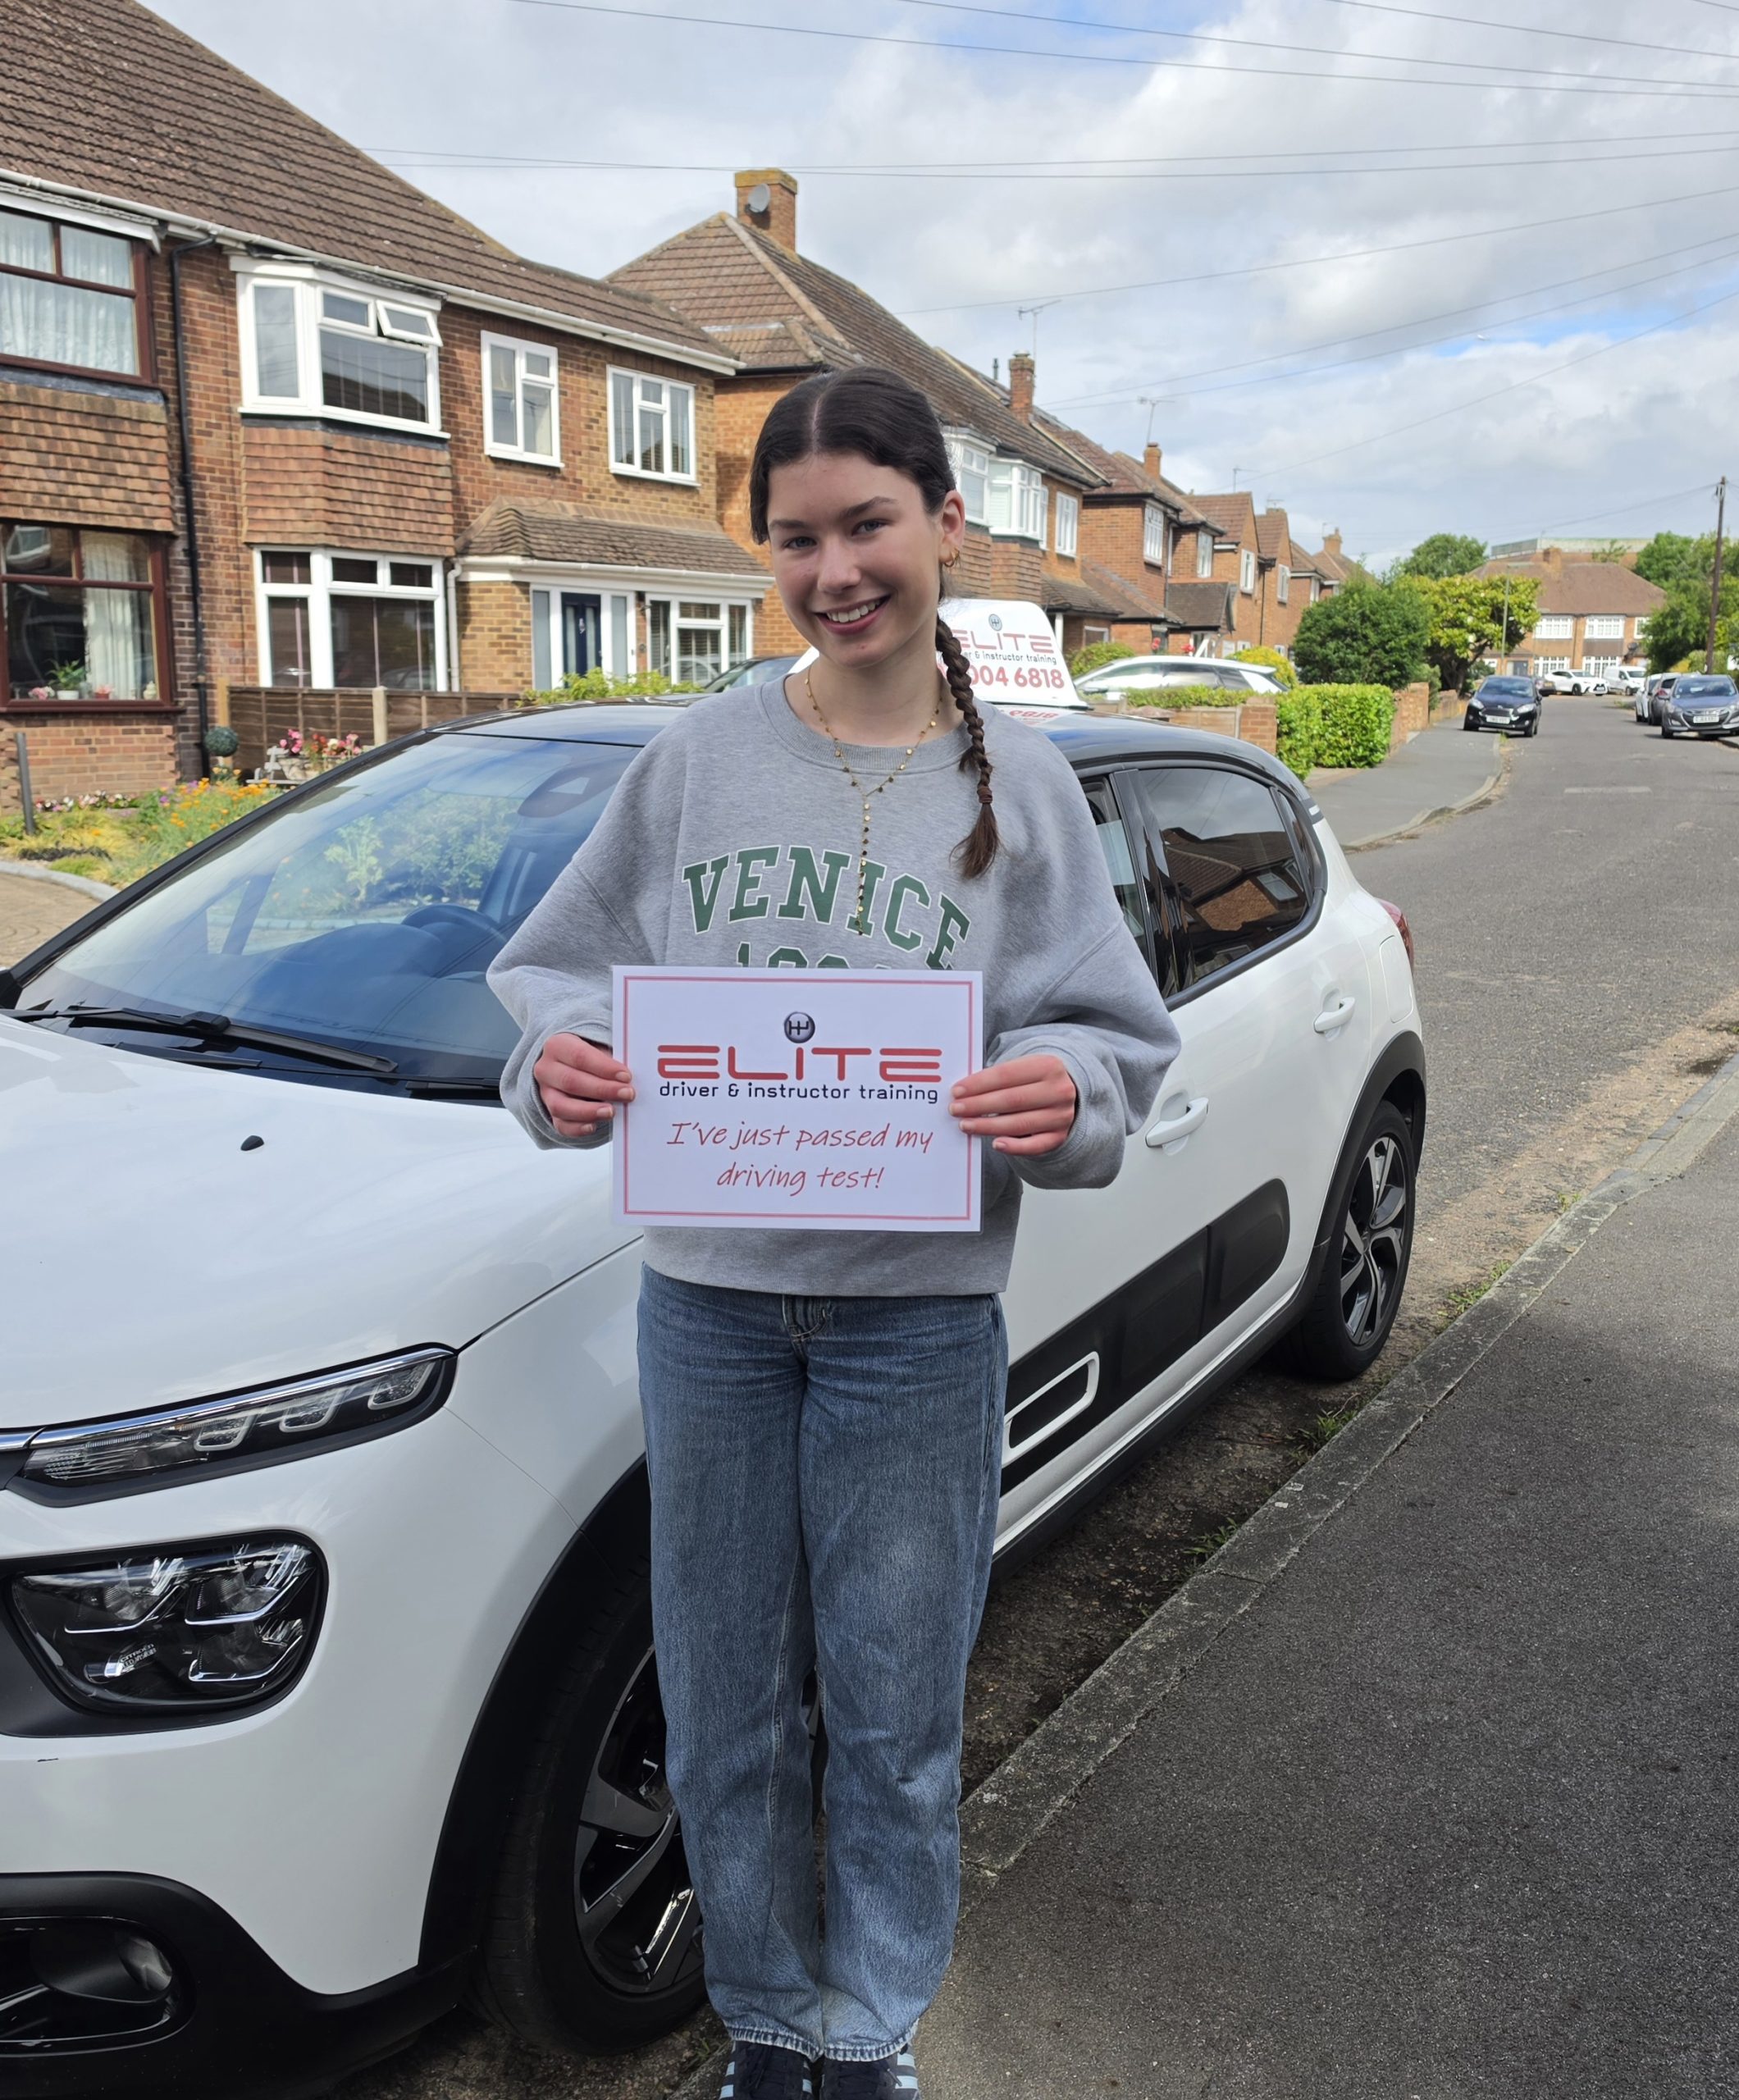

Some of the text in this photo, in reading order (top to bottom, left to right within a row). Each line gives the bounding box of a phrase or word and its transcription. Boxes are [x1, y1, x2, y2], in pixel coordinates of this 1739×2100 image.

[983, 651, 1023, 661] instructor
[1026, 654, 1057, 665] training
[1014, 667, 1065, 689] 6818
[682, 844, 971, 970] VENICE
[657, 1044, 943, 1083] ELITE
[660, 1081, 939, 1105] driver & instructor training
[667, 1121, 933, 1154] I've just passed my
[716, 1162, 886, 1197] driving test!
